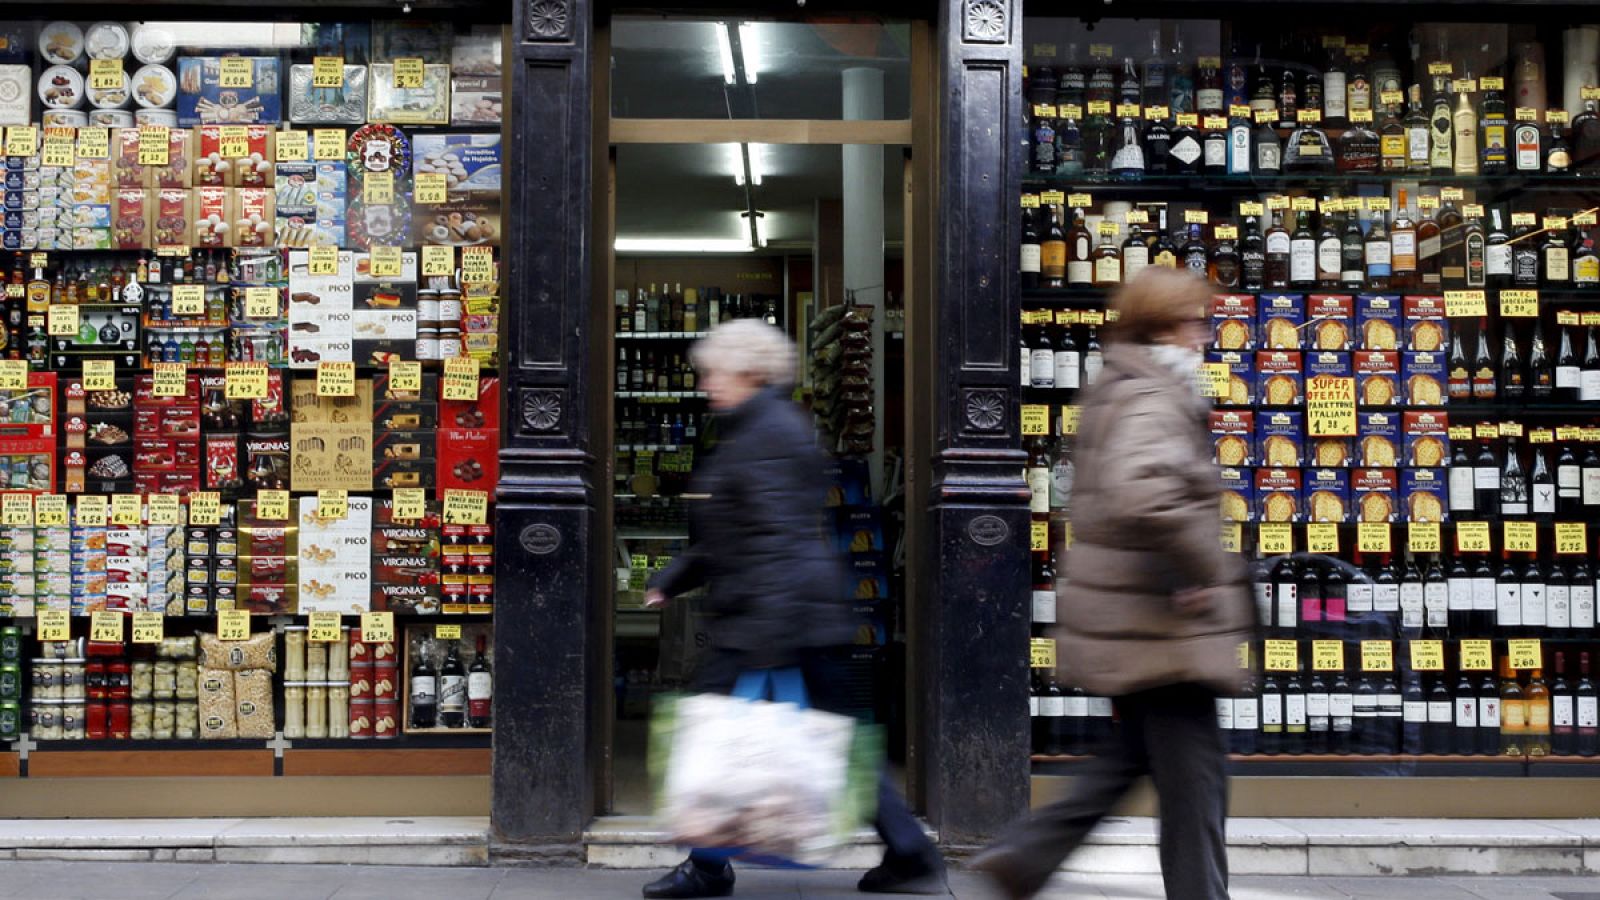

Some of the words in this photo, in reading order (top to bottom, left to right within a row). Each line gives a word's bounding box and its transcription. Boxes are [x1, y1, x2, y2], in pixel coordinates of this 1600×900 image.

[329, 284, 350, 292] PICO
[328, 313, 350, 321] PICO
[391, 314, 414, 322] PICO
[328, 343, 350, 351] PICO
[1360, 361, 1394, 369] PANETTONE
[1306, 391, 1350, 400] OFERTA
[1309, 401, 1353, 409] PANETTONE
[246, 441, 290, 451] VIRGINIAS
[382, 529, 427, 539] VIRGINIAS
[344, 537, 367, 545] PICO
[382, 558, 427, 567] VIRGINIAS
[344, 572, 367, 580] PICO
[382, 586, 427, 596] VIRGINIAS
